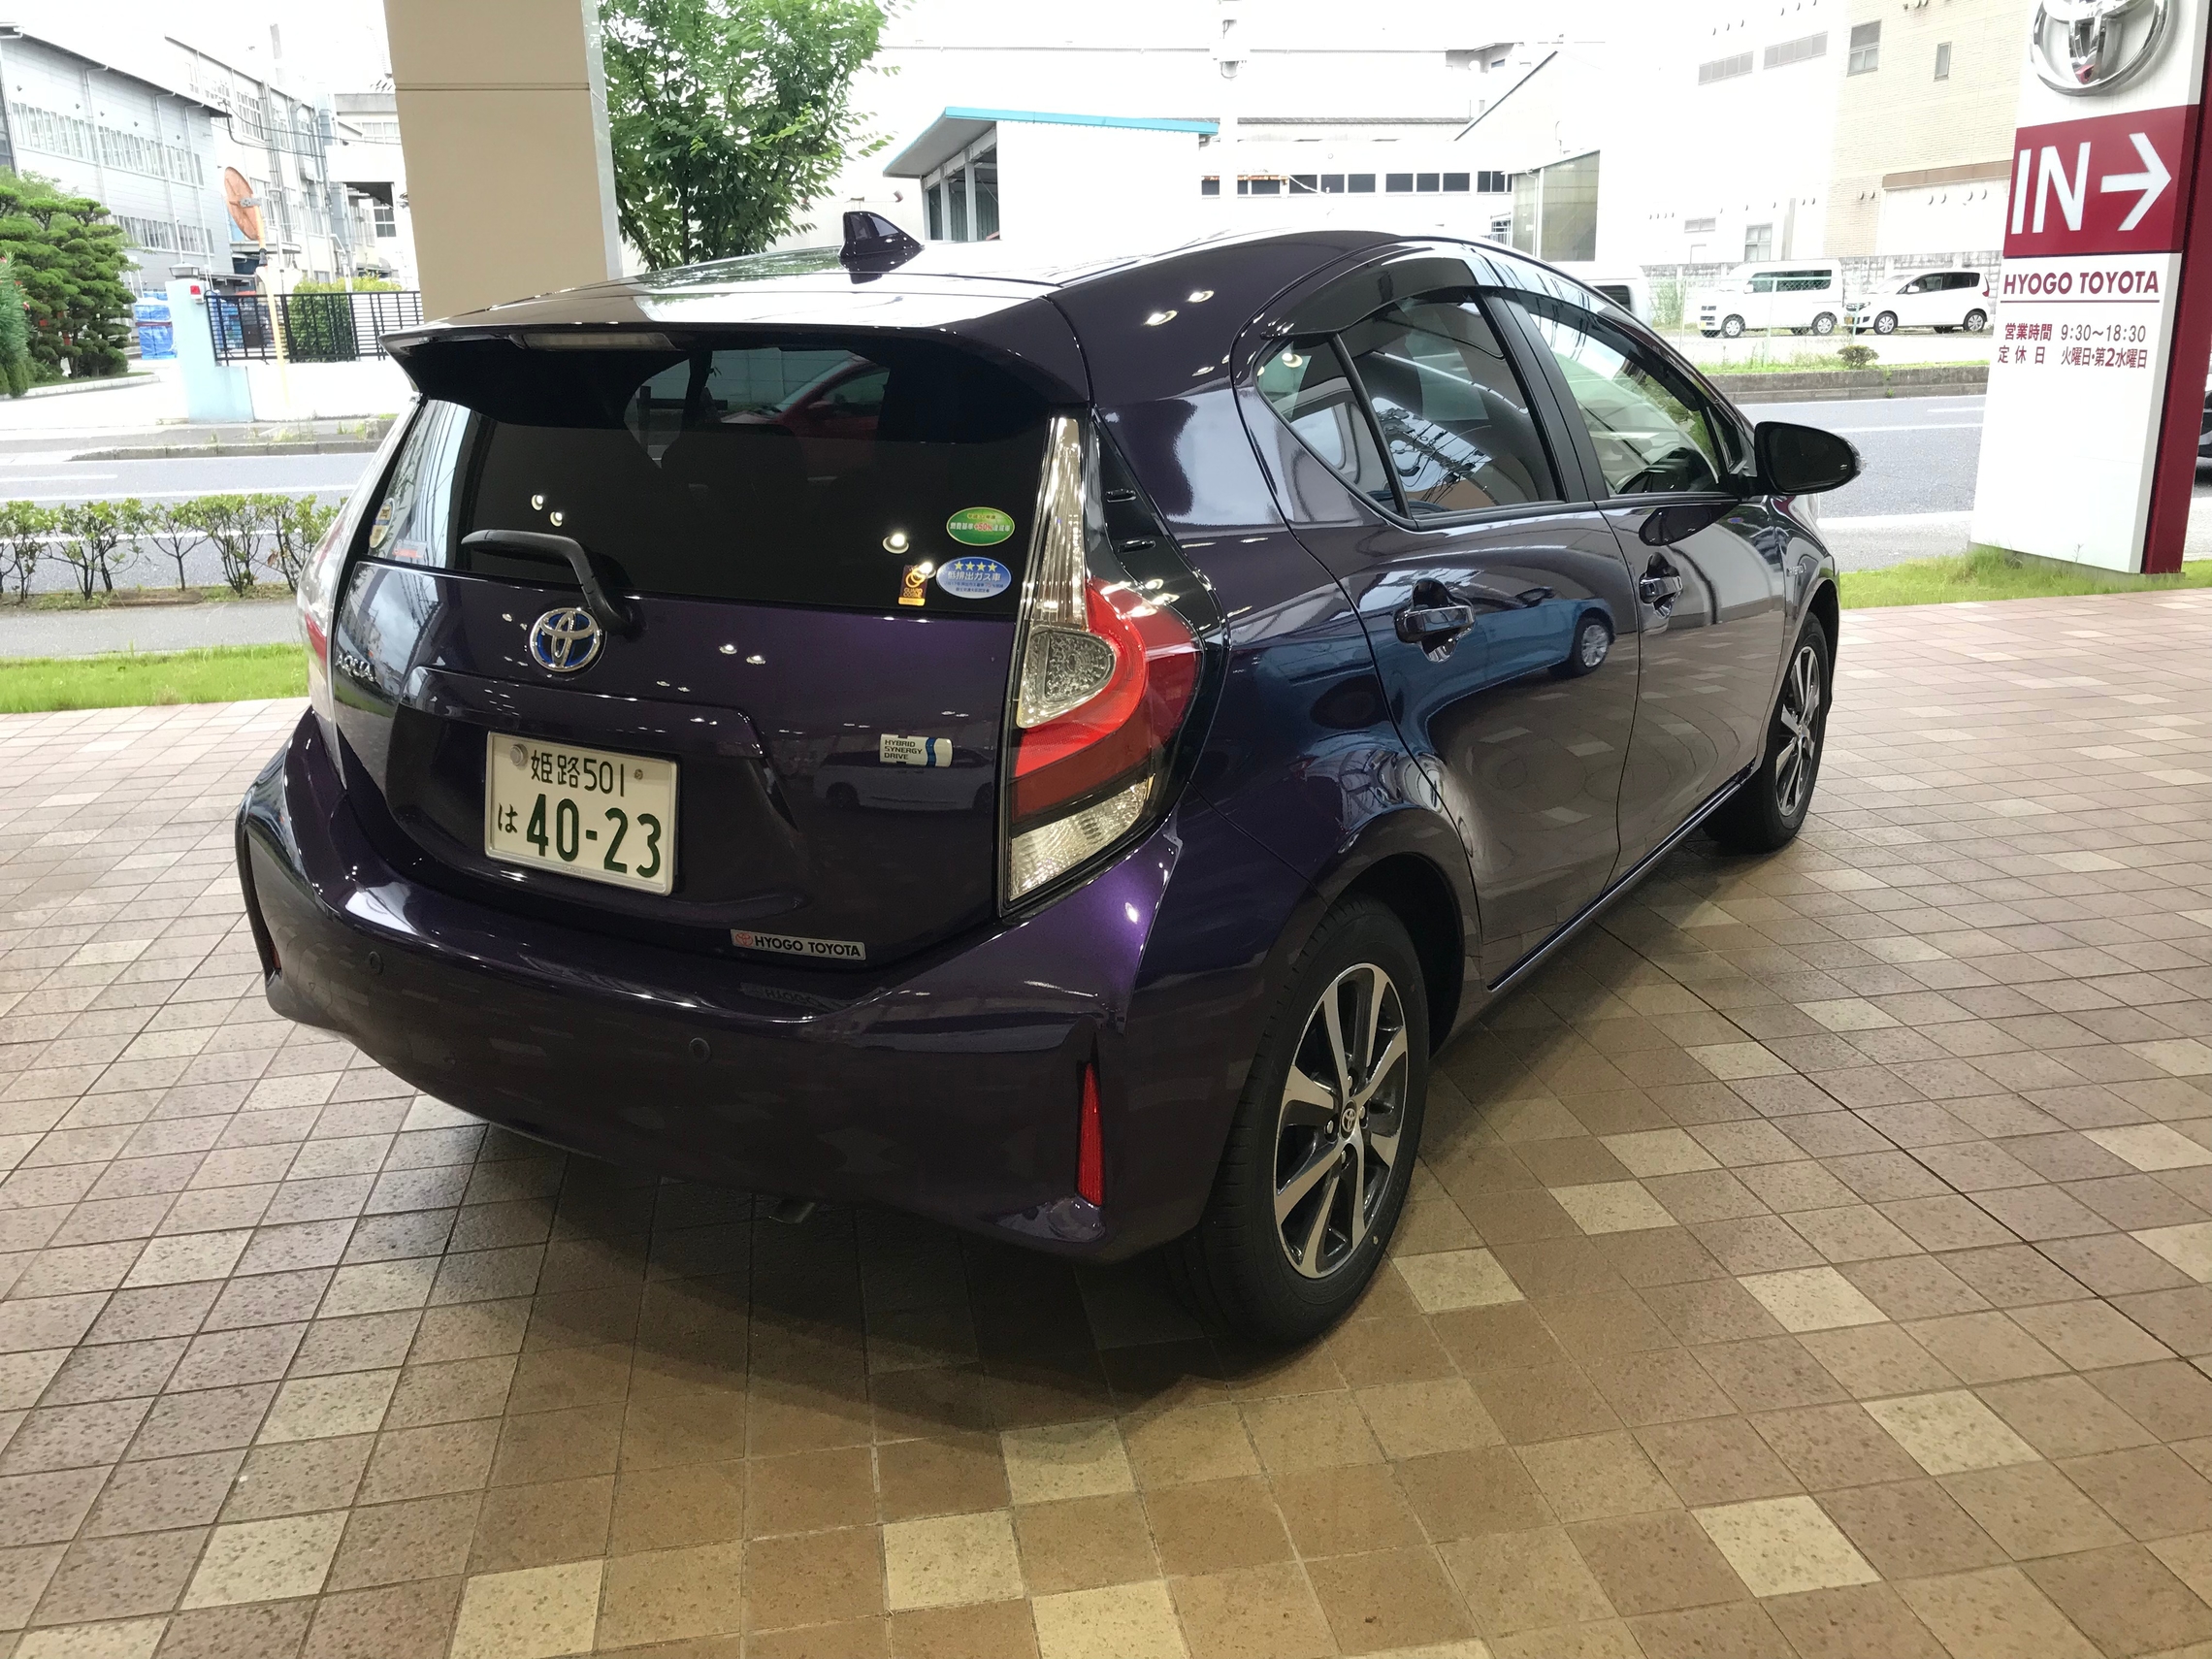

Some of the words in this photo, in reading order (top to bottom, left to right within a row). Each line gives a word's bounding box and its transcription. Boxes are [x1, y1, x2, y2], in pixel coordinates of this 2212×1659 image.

[2011, 141, 2091, 235] IN
[2003, 272, 2073, 295] HYOGO
[2079, 270, 2160, 294] TOYOTA
[2004, 323, 2053, 342] 営業時間
[948, 570, 1001, 582] 低排出ガス車
[884, 739, 916, 748] HYBRID
[498, 803, 518, 833] は
[527, 793, 662, 878] 40-23
[755, 935, 803, 952] HYOGO
[808, 941, 861, 957] TOYOTA
